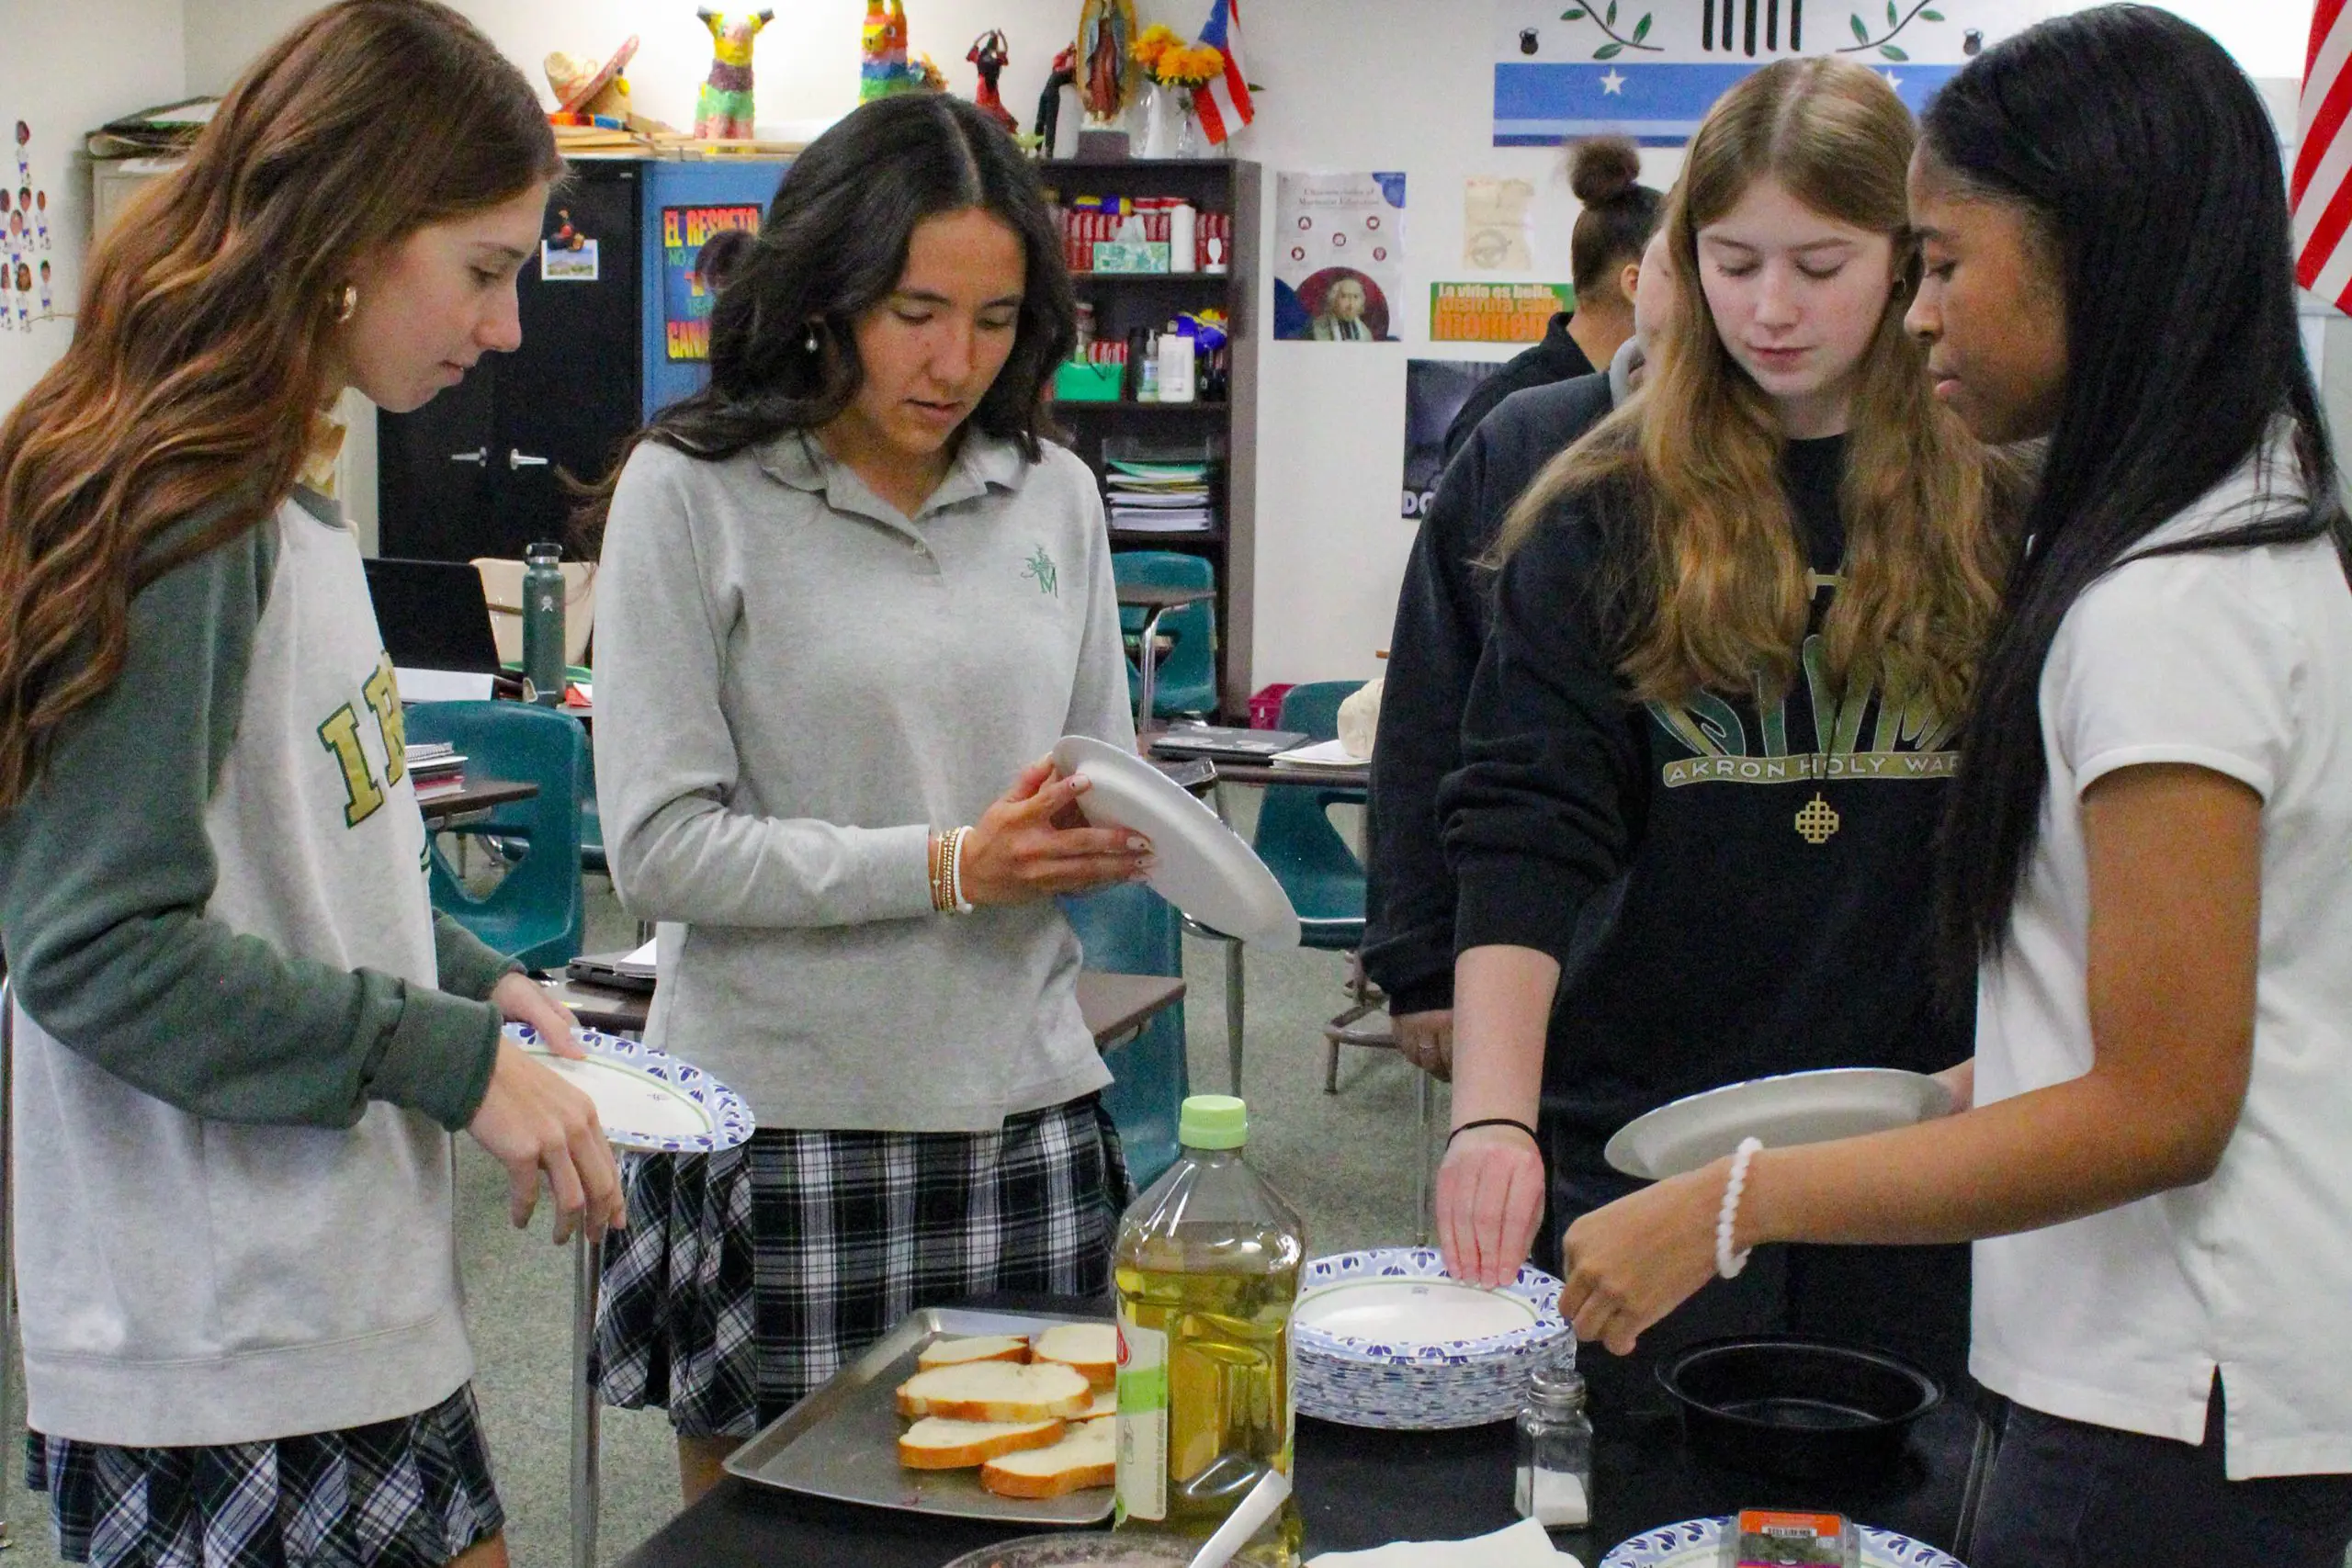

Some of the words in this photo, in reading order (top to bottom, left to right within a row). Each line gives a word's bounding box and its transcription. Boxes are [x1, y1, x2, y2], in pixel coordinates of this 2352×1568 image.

[664, 210, 683, 248] EL
[1439, 283, 1454, 299] La
[1457, 283, 1489, 299] vida
[1492, 285, 1511, 299] es
[1669, 760, 1786, 783] AKRON
[1799, 756, 1886, 774] HOLY
